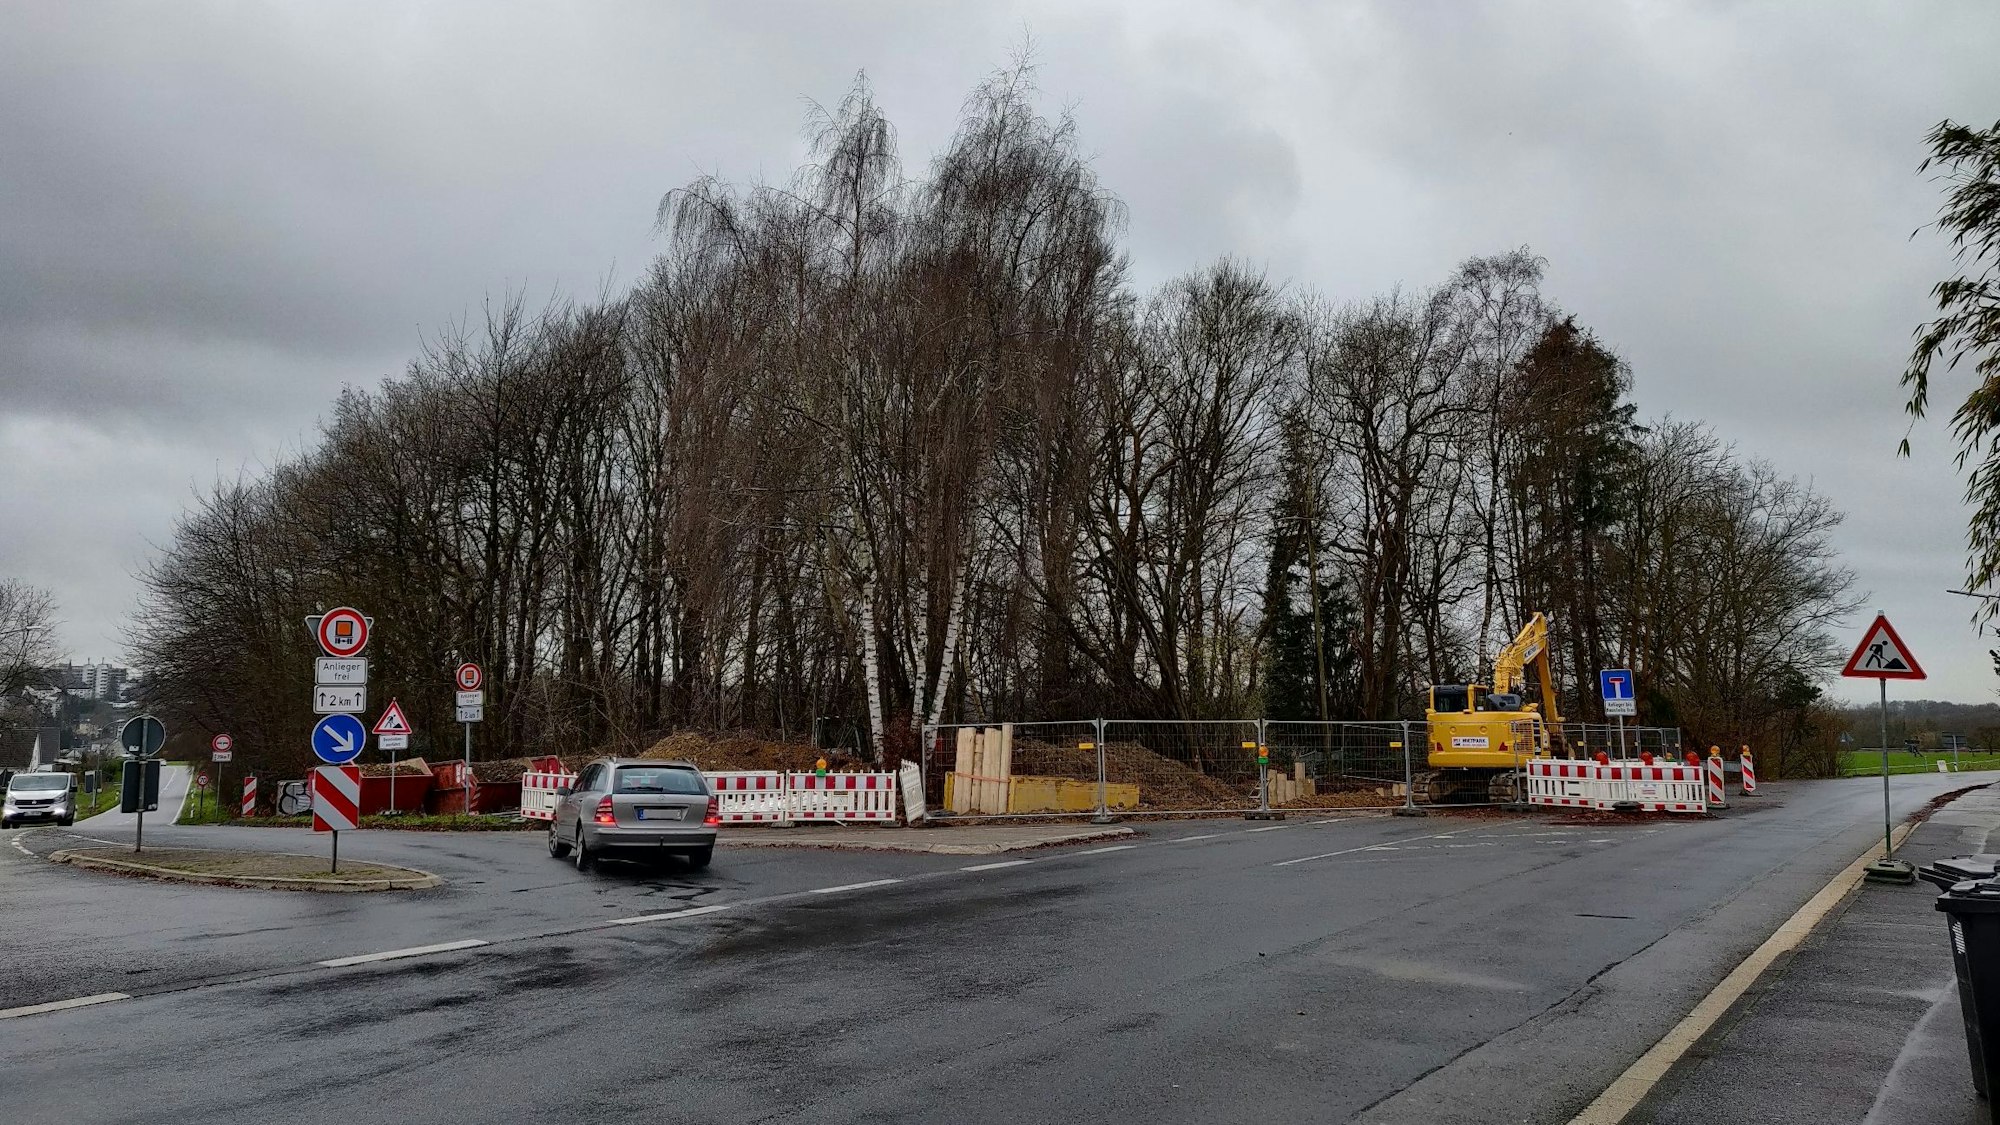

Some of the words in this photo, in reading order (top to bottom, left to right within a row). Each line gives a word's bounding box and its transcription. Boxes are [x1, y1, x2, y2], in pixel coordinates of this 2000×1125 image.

[323, 662, 361, 672] Anlieger
[329, 695, 337, 706] 2
[339, 697, 351, 706] km
[464, 711, 469, 719] 2
